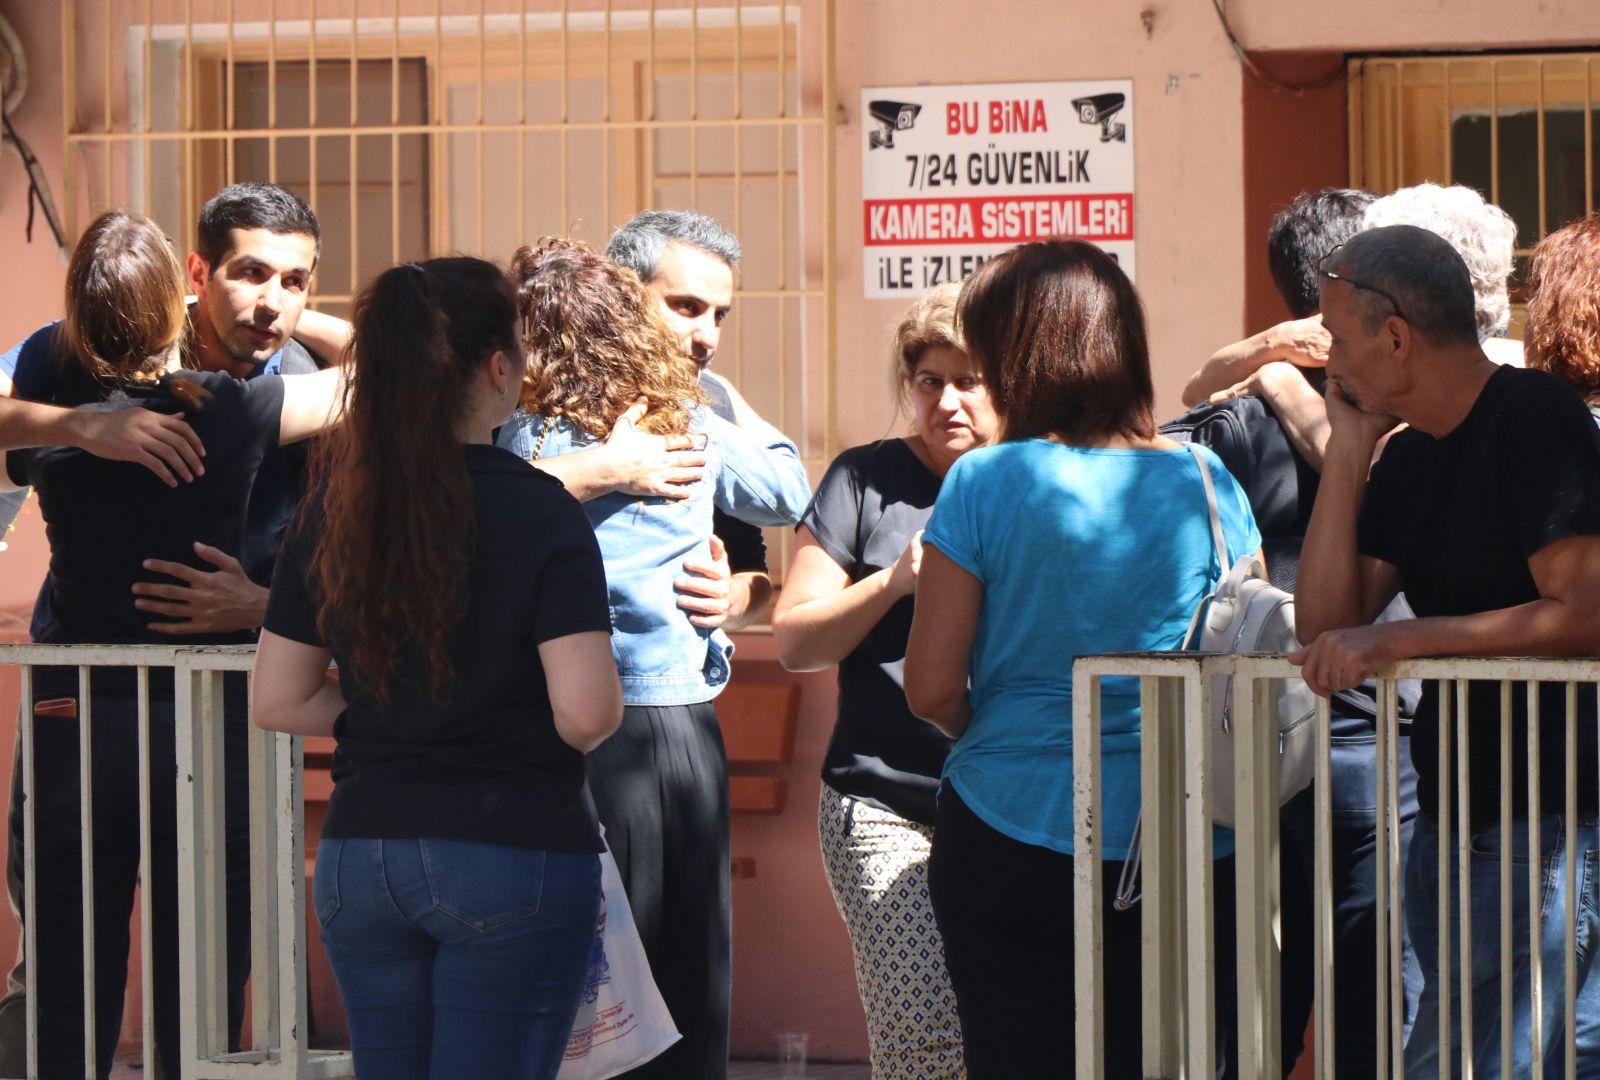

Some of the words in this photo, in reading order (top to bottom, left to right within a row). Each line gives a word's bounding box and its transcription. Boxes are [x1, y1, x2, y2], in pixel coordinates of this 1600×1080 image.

[946, 101, 979, 136] BU
[905, 153, 958, 191] 7/24
[869, 202, 975, 241] KAMERA
